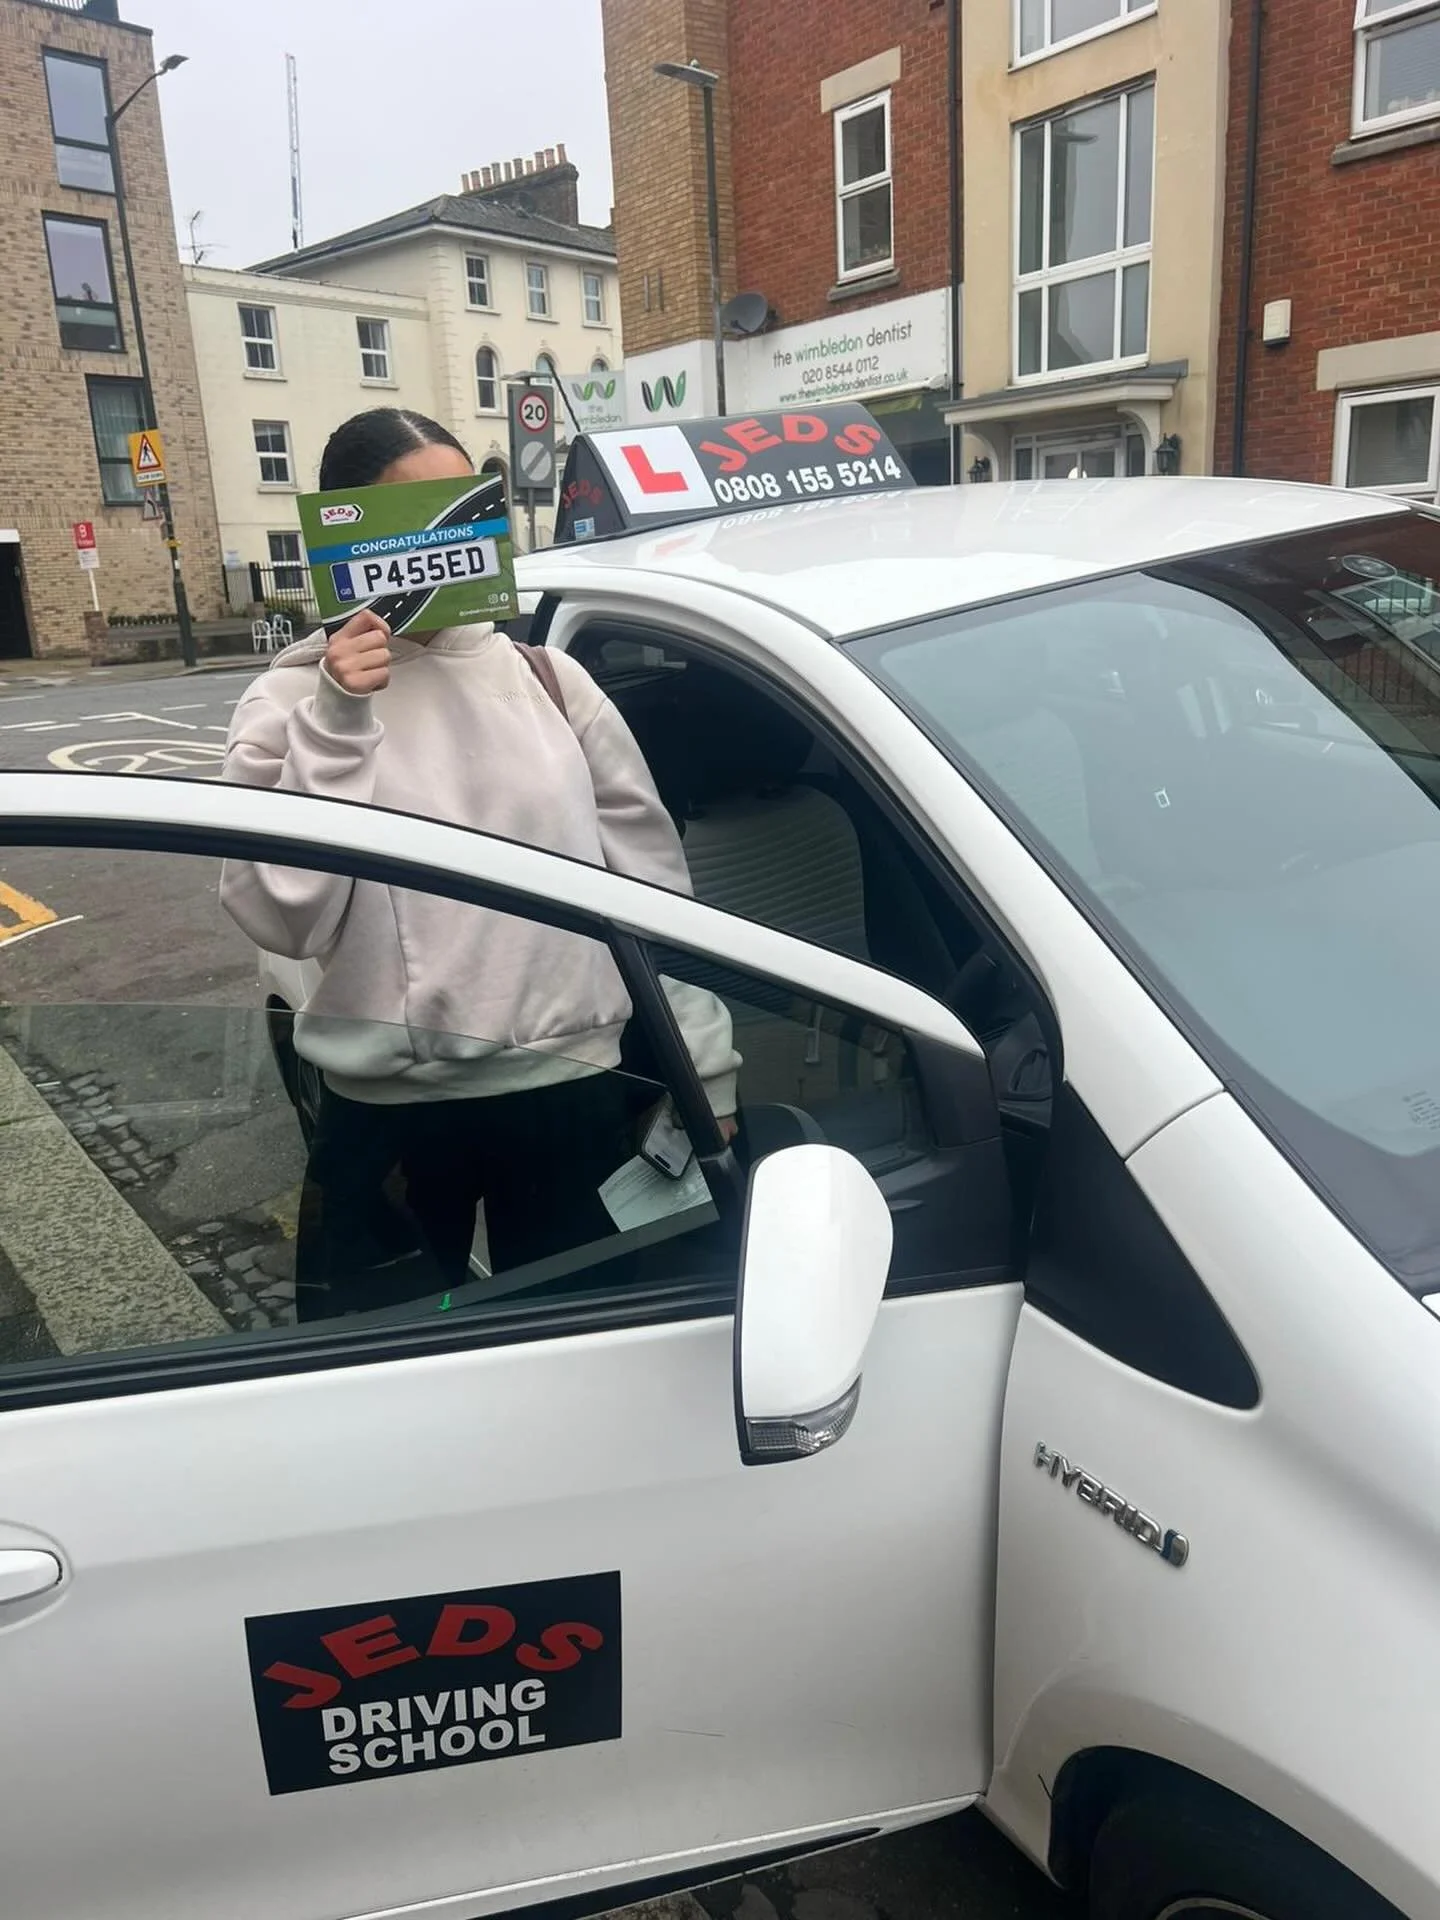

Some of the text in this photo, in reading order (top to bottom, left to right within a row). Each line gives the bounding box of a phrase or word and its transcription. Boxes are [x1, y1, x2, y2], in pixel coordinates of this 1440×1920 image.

[773, 321, 913, 368] the wimbledon dentist
[802, 356, 880, 385] 020 8544 0112
[524, 404, 545, 421] 20
[700, 414, 881, 473] JEDS
[620, 444, 689, 494] L
[715, 455, 901, 504] 0808 155 5214
[323, 507, 355, 520] JEDS
[351, 526, 474, 555] CONGRATULATIONS
[363, 546, 486, 592] P455ED
[1034, 1440, 1163, 1553] HYBRID
[263, 1604, 604, 1709] JEDS
[321, 1678, 546, 1741] DRIVING
[328, 1715, 546, 1775] SCHOOL
